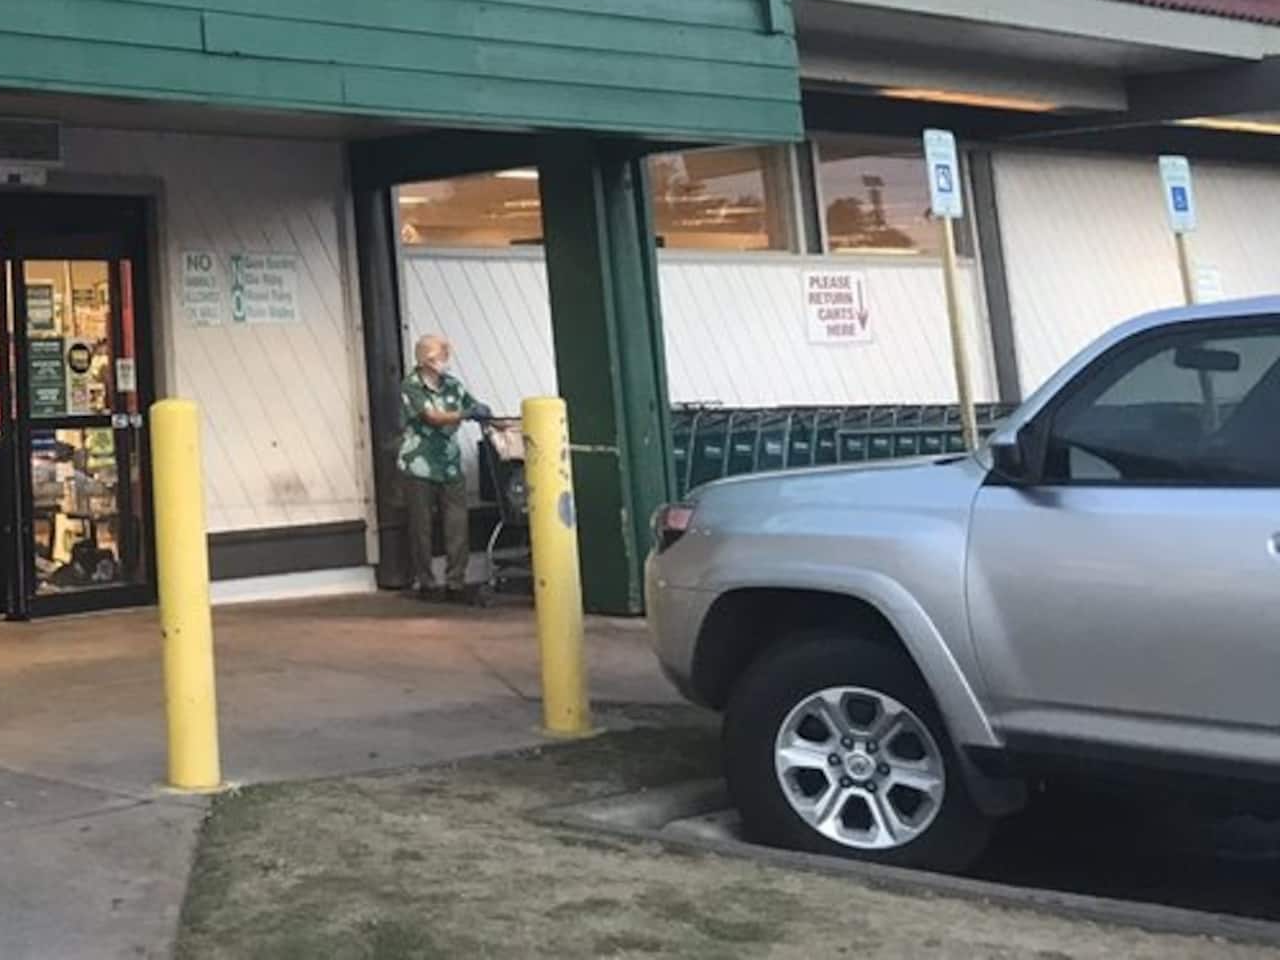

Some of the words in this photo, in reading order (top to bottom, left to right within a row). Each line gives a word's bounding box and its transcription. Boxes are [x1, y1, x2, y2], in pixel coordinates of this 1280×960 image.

[186, 254, 212, 272] NO
[809, 275, 851, 289] PLEASE
[808, 291, 853, 305] RETURN
[817, 307, 855, 321] CARTS
[826, 323, 856, 337] HERE
